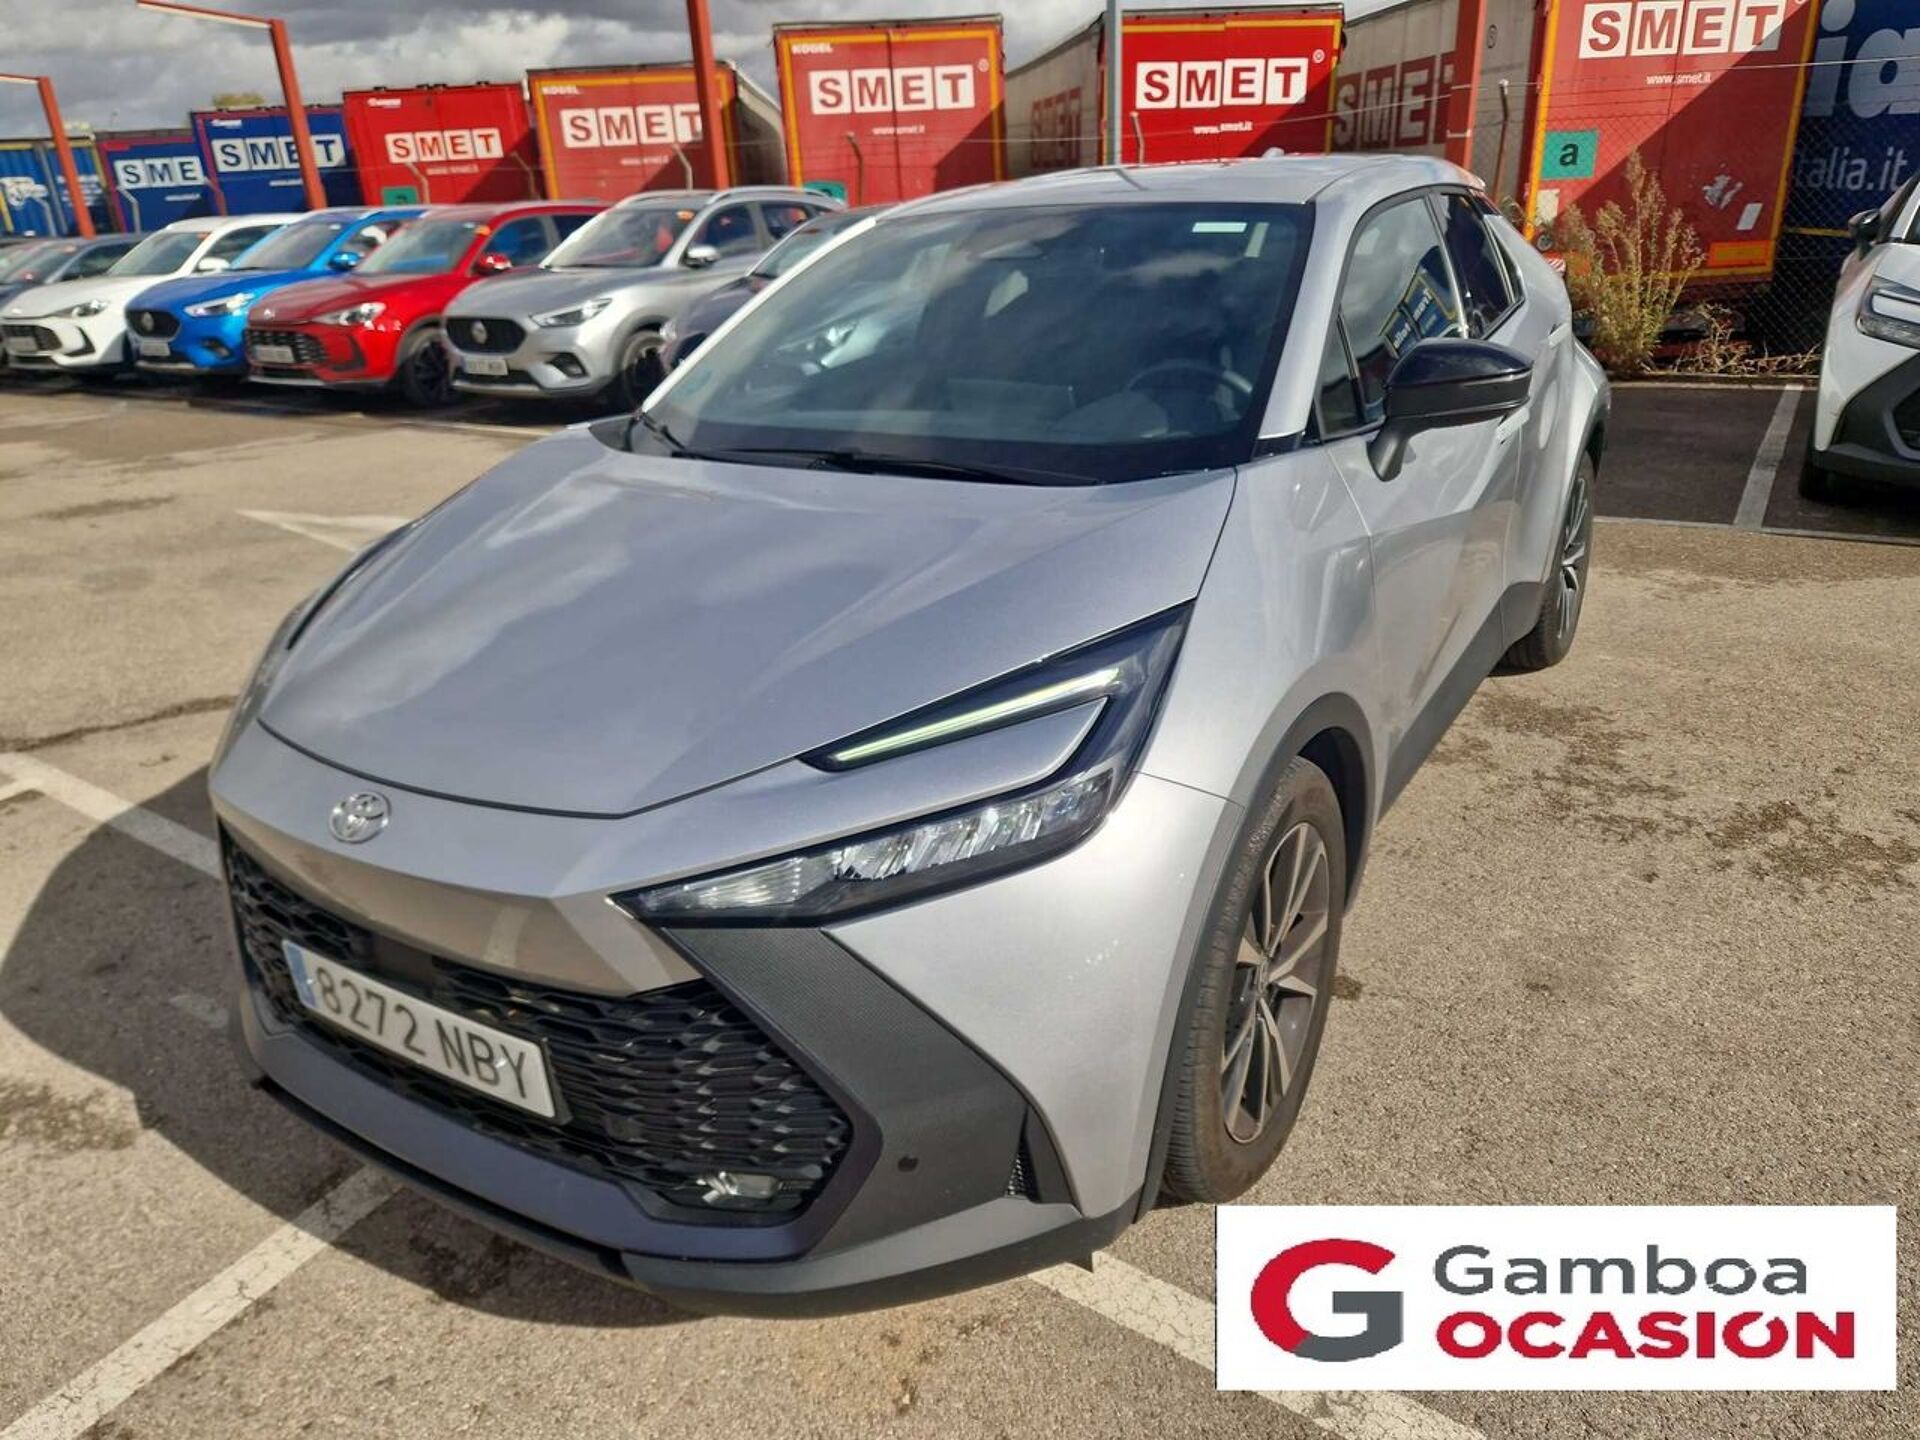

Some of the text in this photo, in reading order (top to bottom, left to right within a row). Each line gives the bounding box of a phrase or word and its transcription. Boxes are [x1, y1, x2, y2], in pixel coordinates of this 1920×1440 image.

[1588, 6, 1779, 52] SMET
[819, 72, 967, 108] SMET
[1143, 66, 1301, 103] SMET
[1646, 71, 1712, 85] www.smet.it
[393, 134, 495, 158] SMET
[1559, 142, 1580, 167] a
[315, 966, 527, 1099] 8272 NBY
